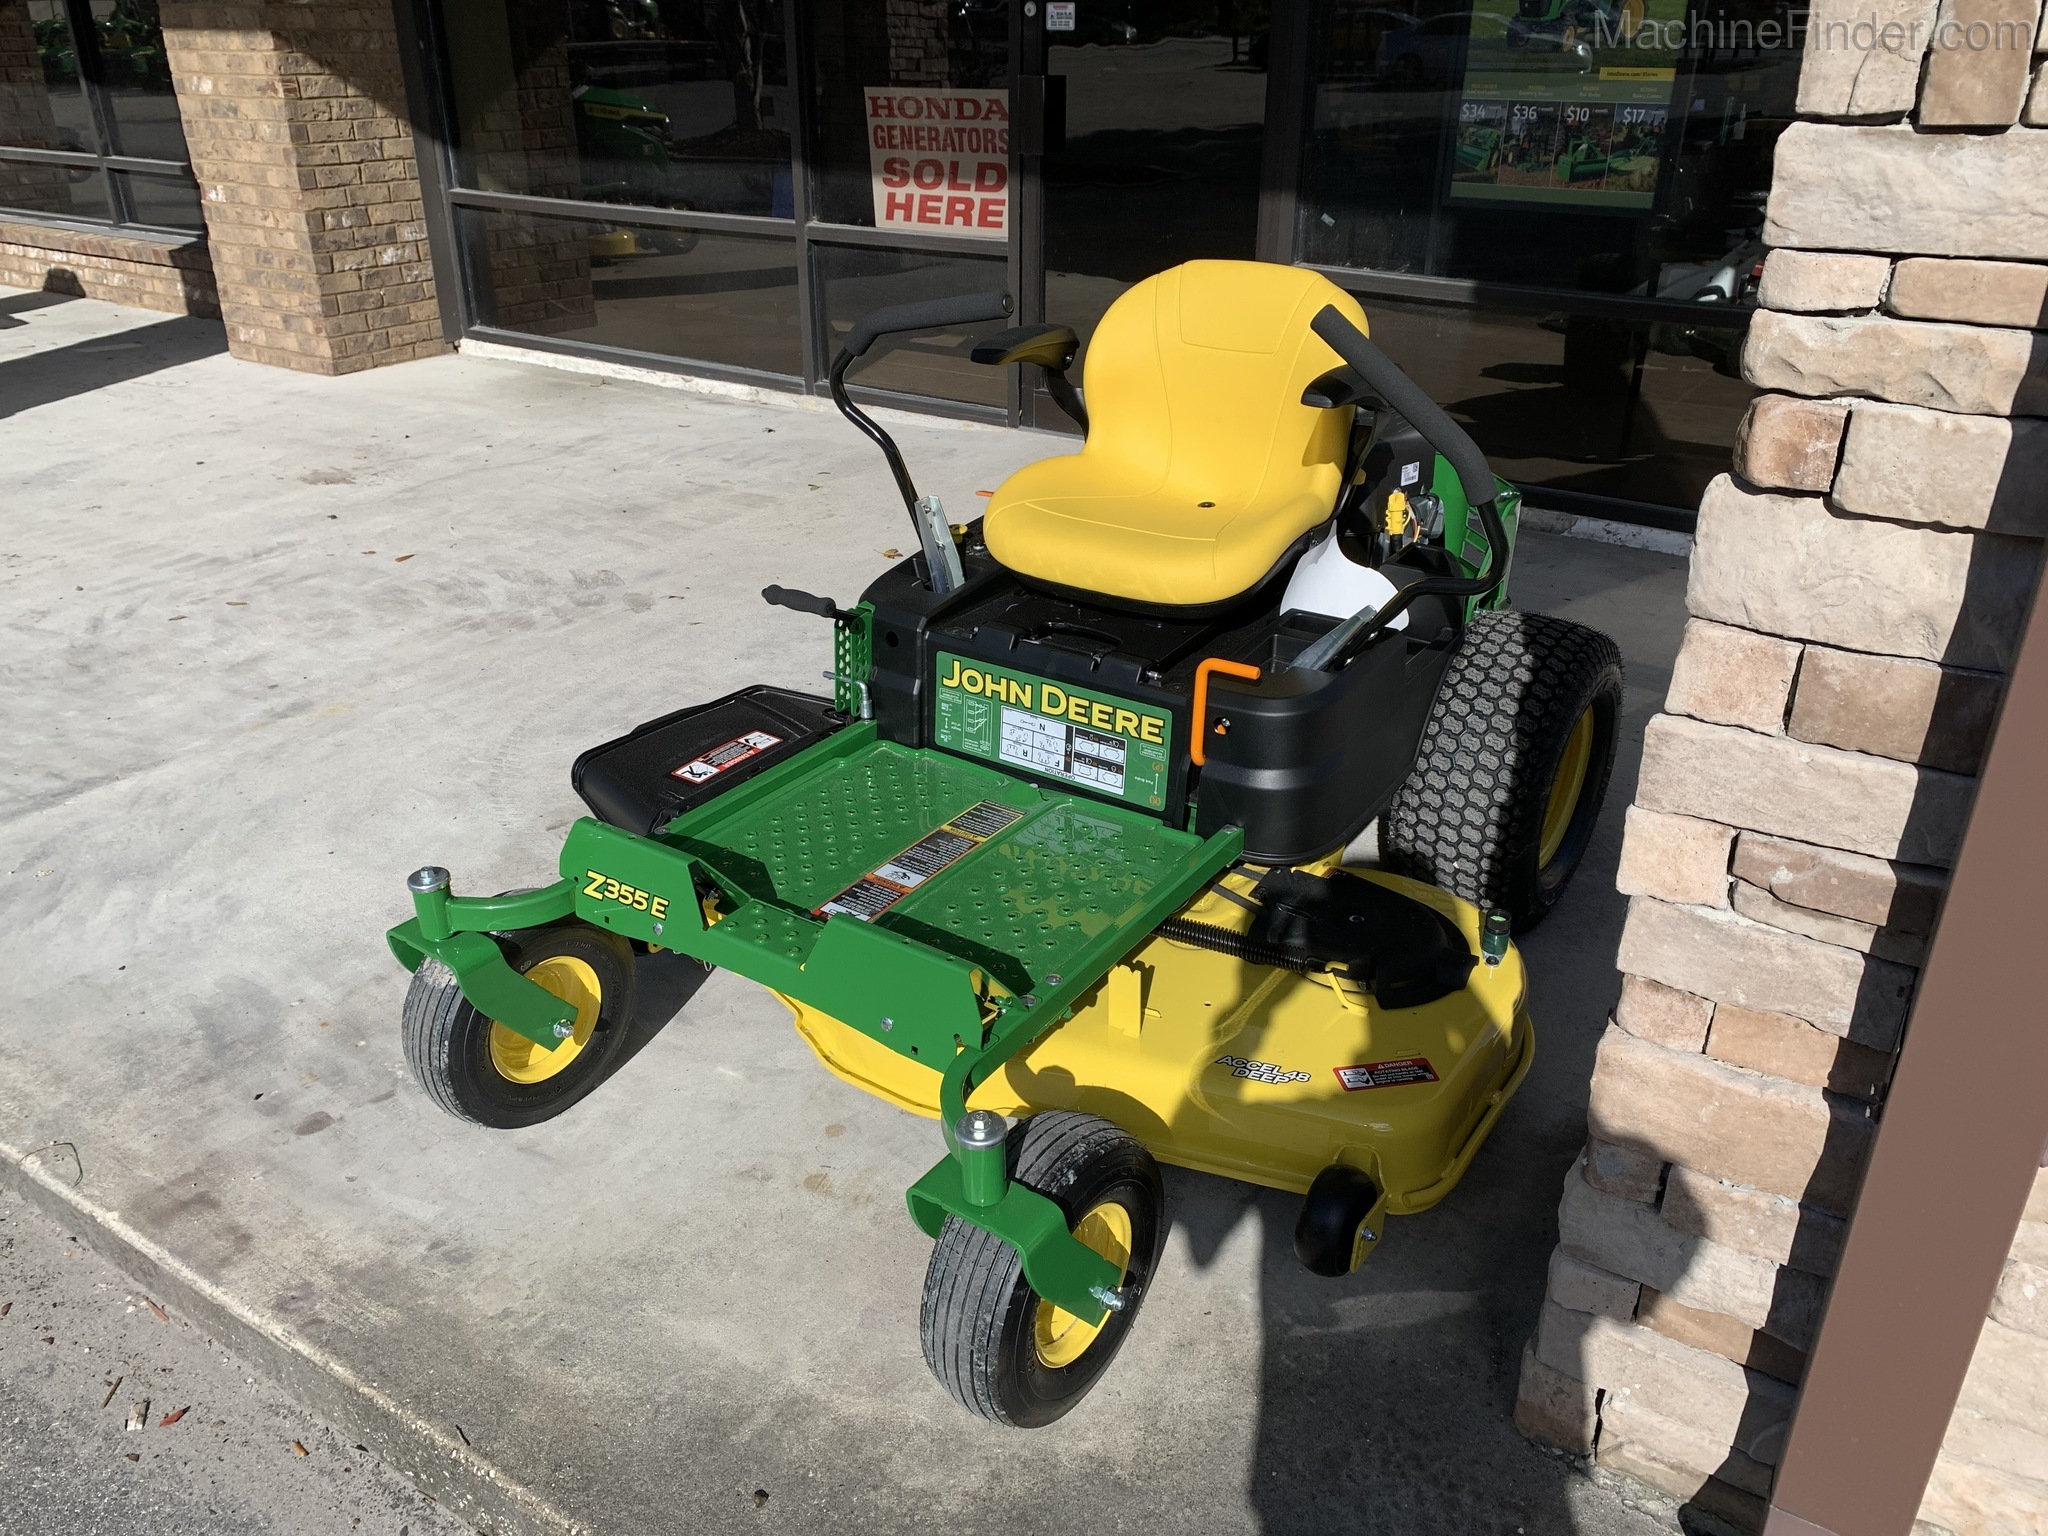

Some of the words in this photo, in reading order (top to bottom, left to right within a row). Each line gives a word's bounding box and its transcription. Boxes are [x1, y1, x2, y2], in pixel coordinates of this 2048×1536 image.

[868, 96, 1008, 121] HONDA
[1462, 102, 1486, 120] $34
[1513, 103, 1537, 120] $36
[1567, 105, 1590, 123] $10
[1622, 107, 1646, 125] $17
[873, 124, 1008, 154] GENERATORS
[882, 157, 1008, 193] SOLD
[885, 191, 1006, 228] HERE
[942, 659, 1033, 709] JOHN
[1040, 682, 1166, 744] DEERE
[1044, 767, 1076, 780] OPERATION
[582, 869, 650, 911] Z355
[650, 895, 670, 920] E
[1215, 1056, 1284, 1076] ACCEL
[1232, 1067, 1290, 1084] DEEP
[1283, 1070, 1311, 1082] 48
